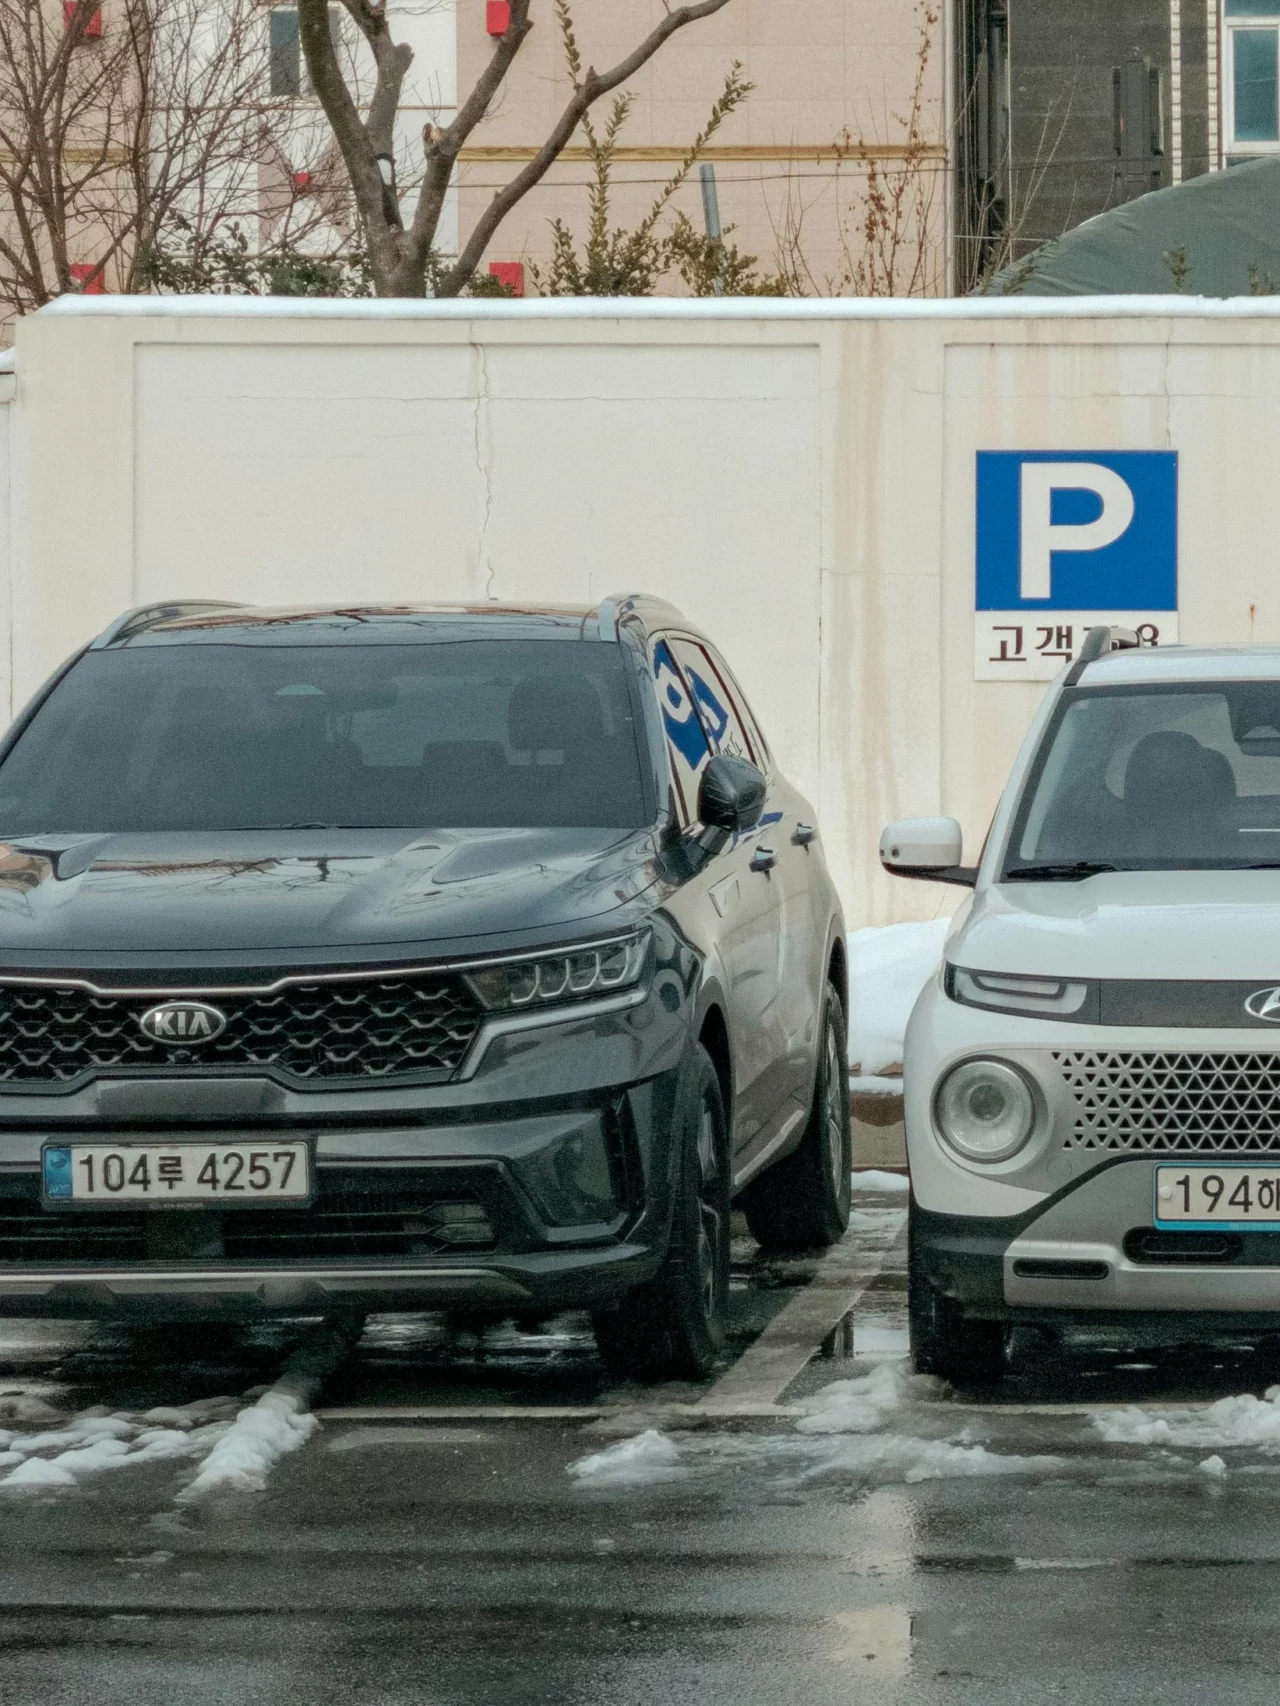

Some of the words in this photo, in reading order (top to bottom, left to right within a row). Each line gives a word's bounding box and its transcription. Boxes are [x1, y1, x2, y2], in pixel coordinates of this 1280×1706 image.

[1020, 462, 1135, 600] P
[989, 622, 1160, 664] 고객
[154, 1011, 212, 1036] KIA
[79, 1153, 183, 1192] 104루
[197, 1152, 296, 1191] 4257
